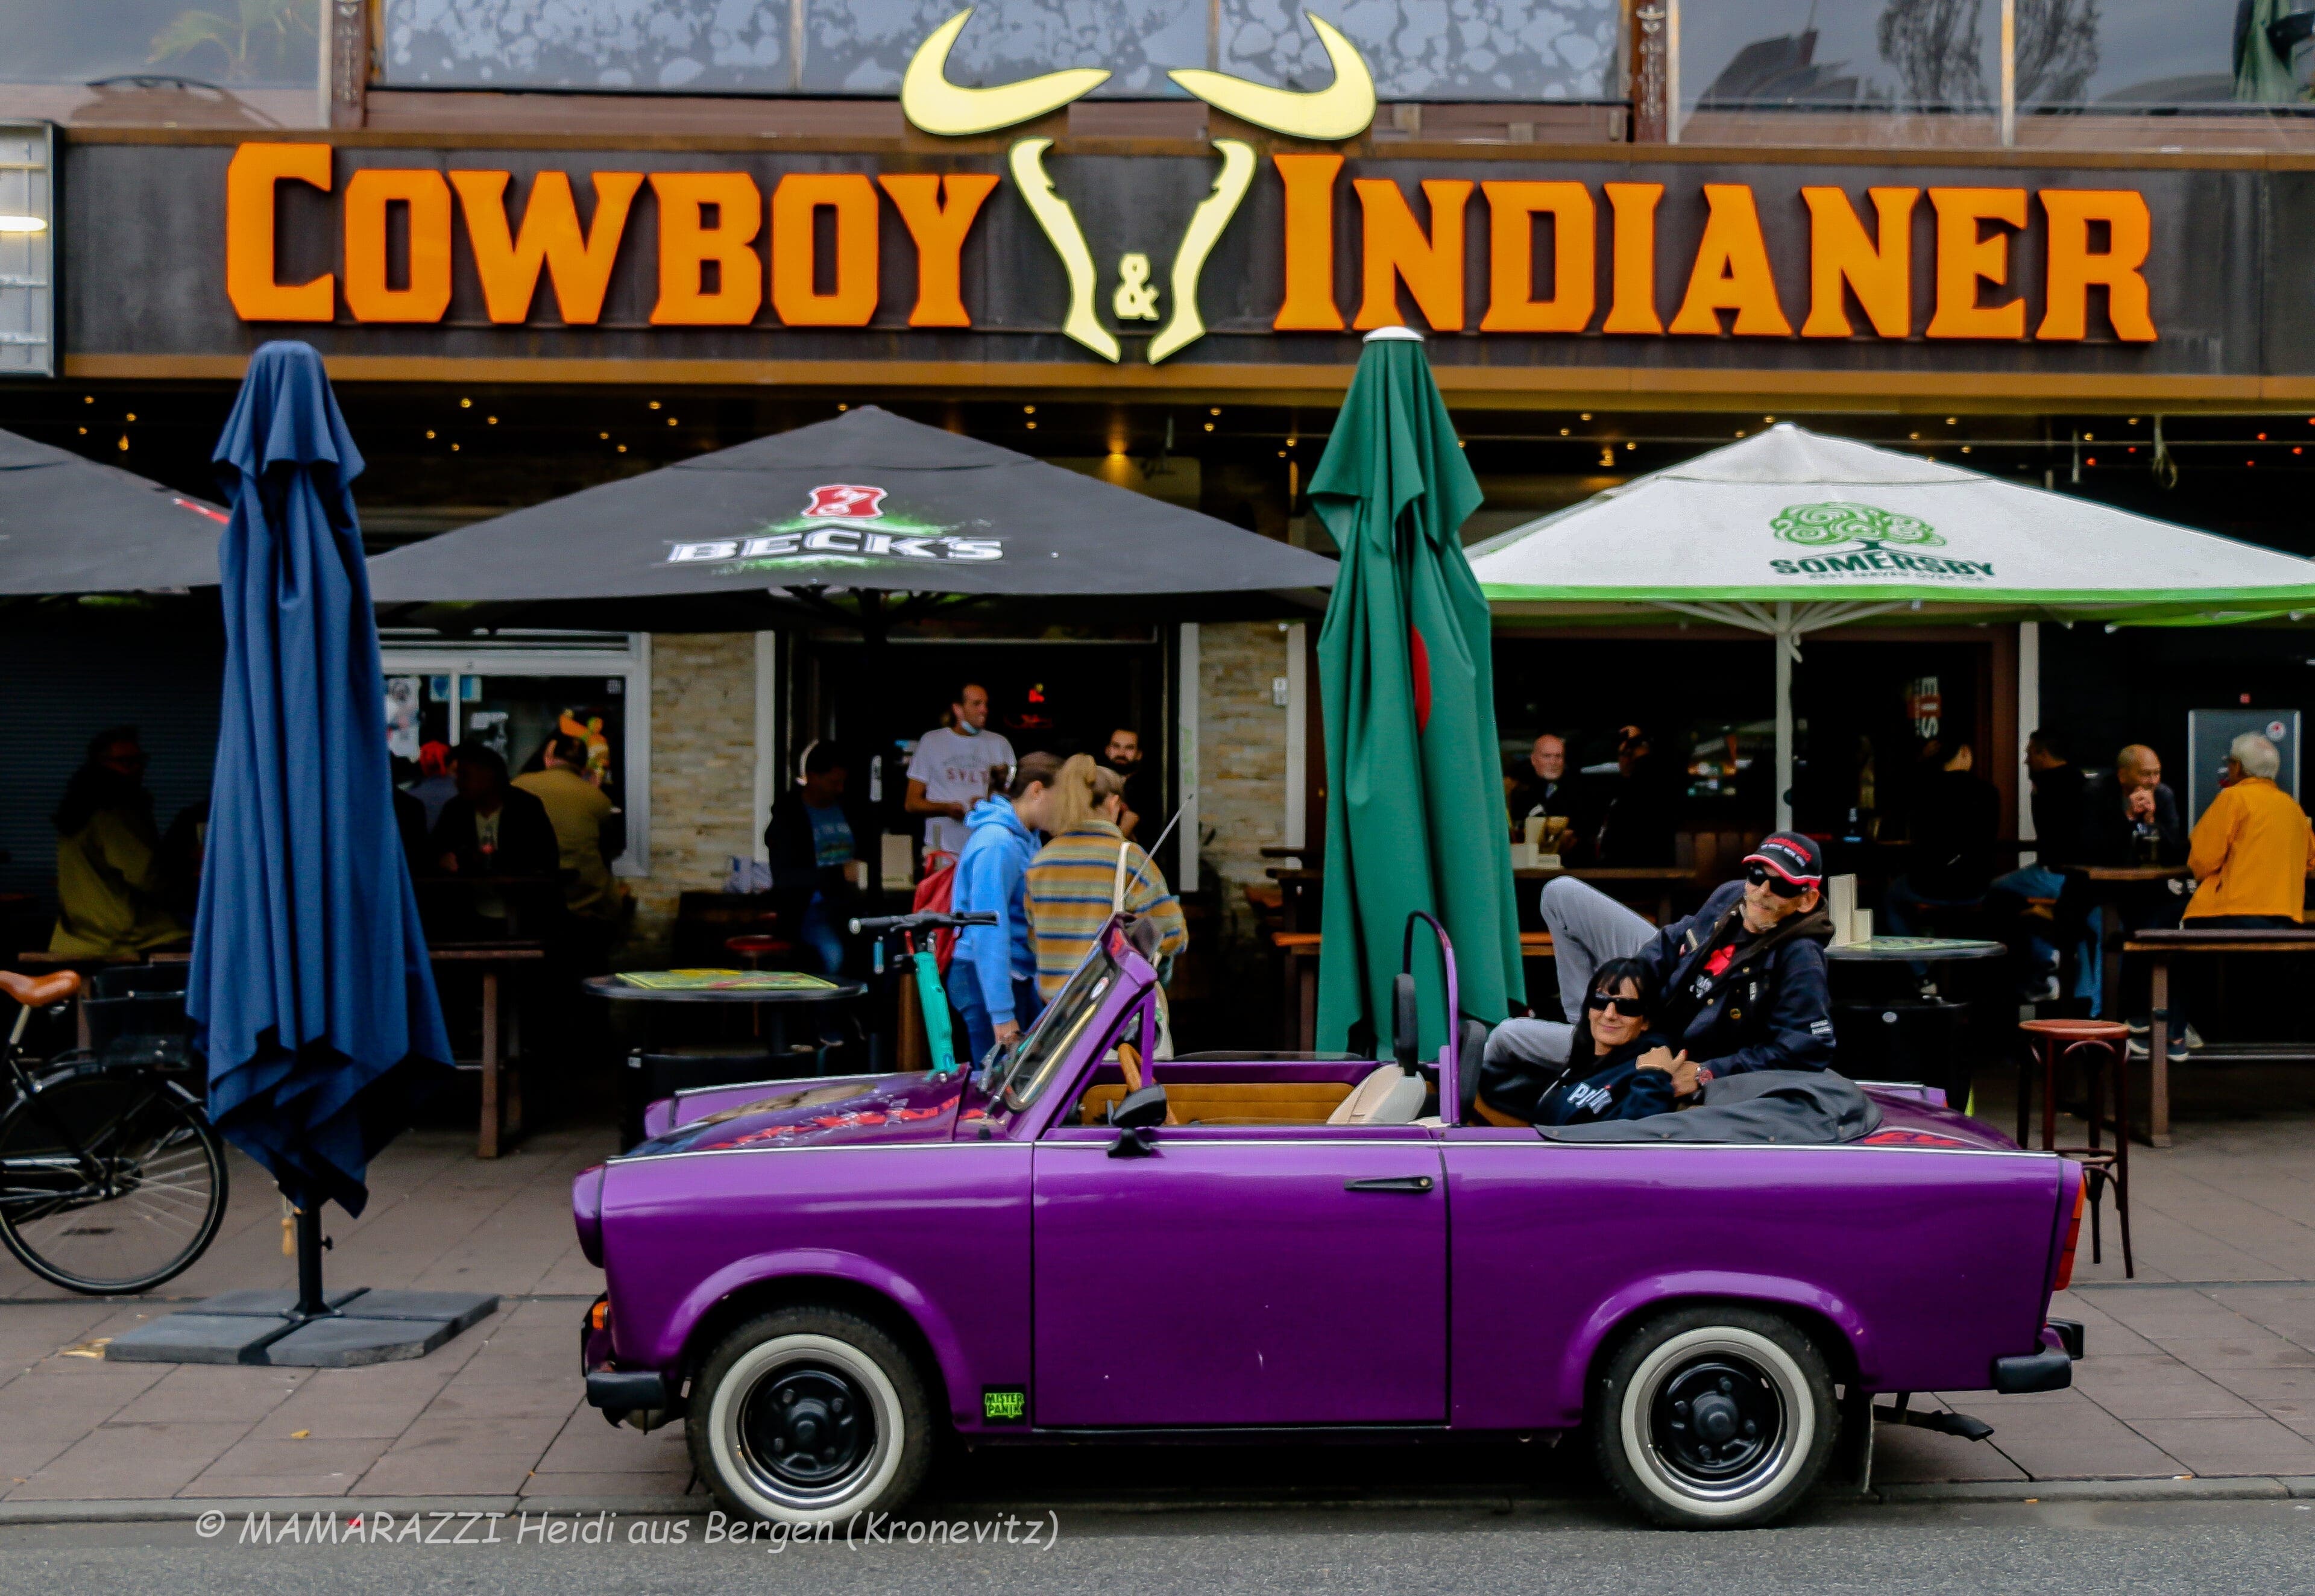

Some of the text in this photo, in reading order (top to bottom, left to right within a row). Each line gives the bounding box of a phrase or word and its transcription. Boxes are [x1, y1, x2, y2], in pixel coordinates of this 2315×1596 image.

[227, 143, 2158, 341] COWBOY & INDIANER
[665, 528, 1004, 563] BECK'S
[1769, 551, 1995, 577] SOMERSBY
[984, 1392, 1024, 1406] MISTER
